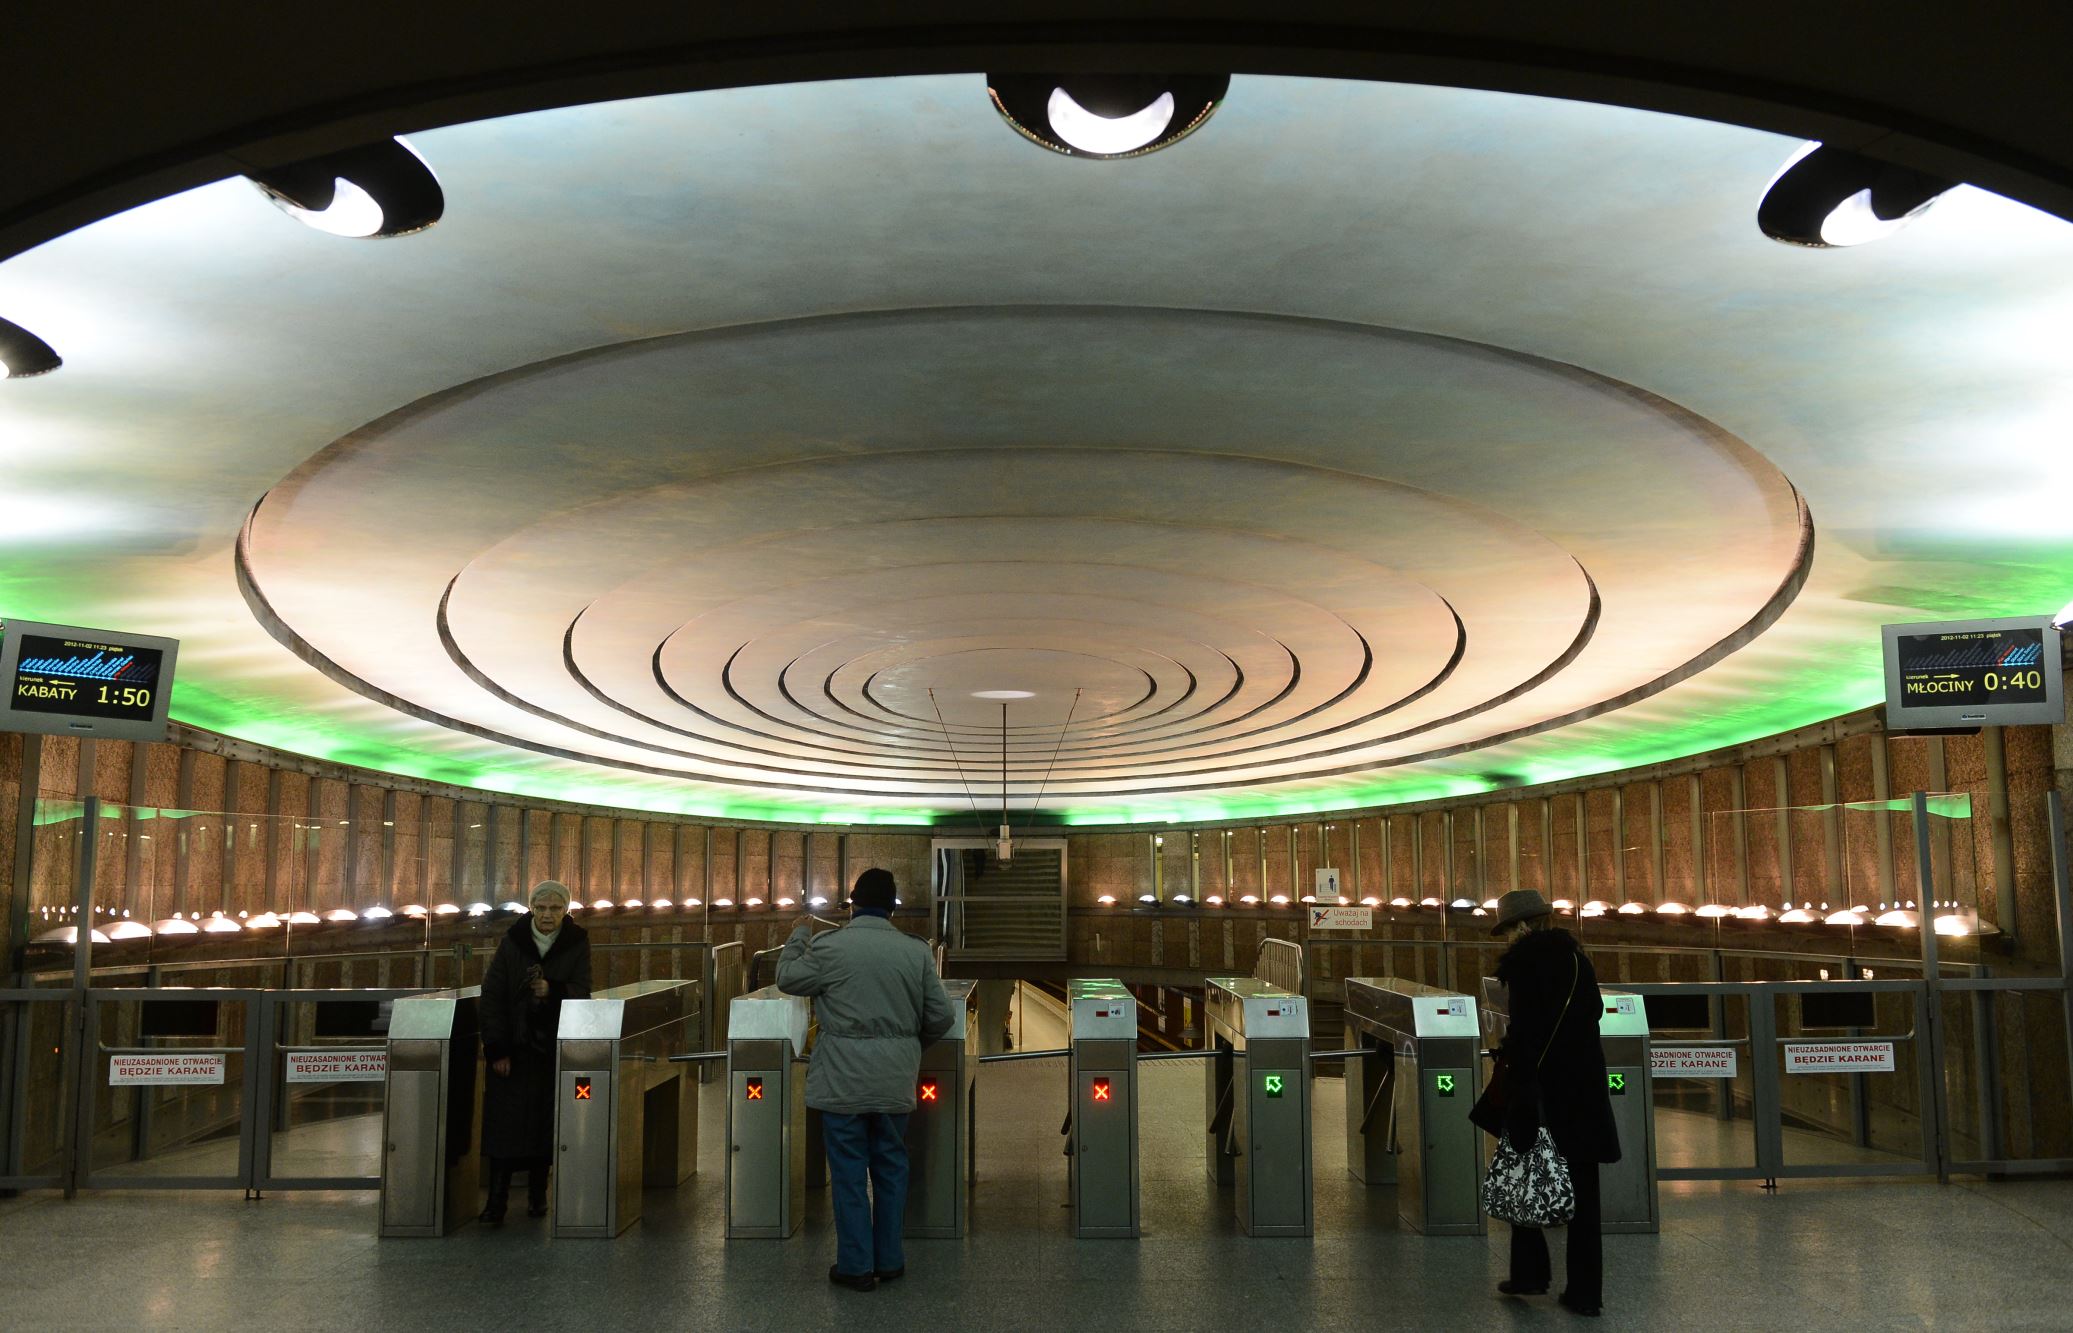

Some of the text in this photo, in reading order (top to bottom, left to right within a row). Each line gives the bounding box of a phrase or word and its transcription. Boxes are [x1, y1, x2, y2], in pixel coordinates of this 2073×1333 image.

[1941, 632, 1969, 641] 2012-11-02
[1984, 671, 2041, 691] 0:40
[18, 684, 78, 700] KABATY
[1907, 680, 1974, 694] MŁOCINY
[97, 686, 150, 707] 1:50
[290, 1055, 357, 1063] NIEUZASADNIONE
[1650, 1051, 1733, 1059] ASADNIONE OTWARCIE
[1794, 1054, 1886, 1065] BĘDZIE KARANE
[113, 1058, 179, 1066] NIEUZASADNIONE
[1651, 1060, 1728, 1068] DZIE KARANE
[119, 1066, 216, 1077] BĘDZIE KARANE
[296, 1063, 385, 1074] BĘDZIE KARAN
